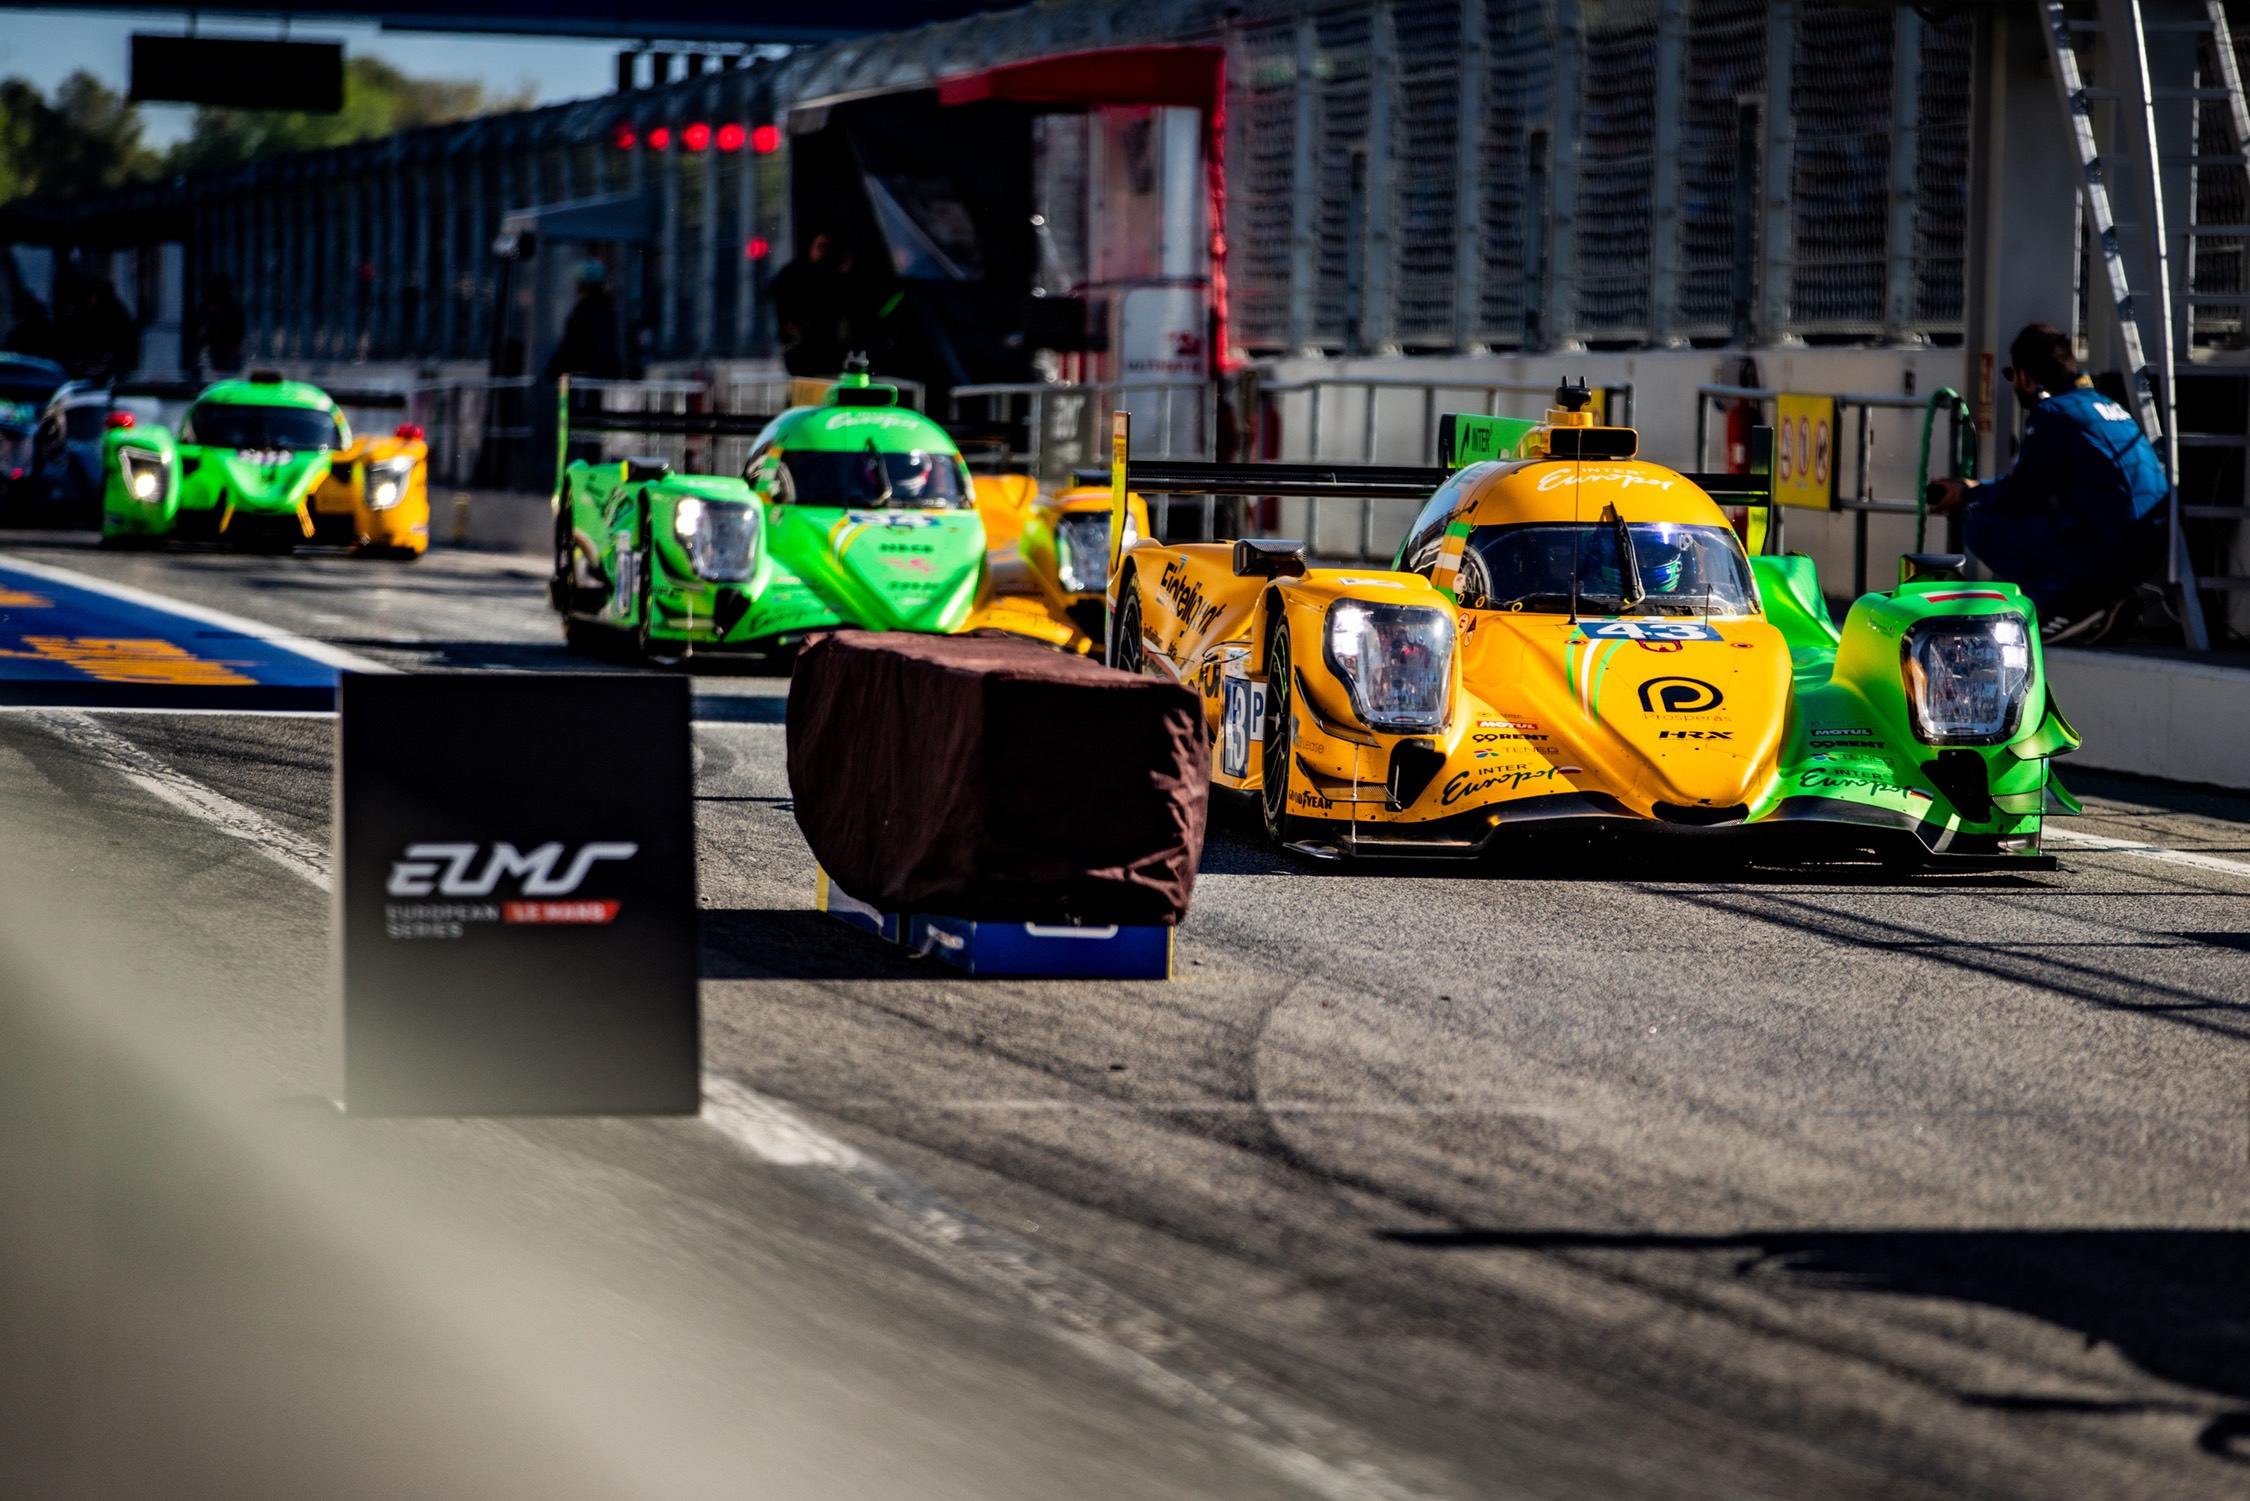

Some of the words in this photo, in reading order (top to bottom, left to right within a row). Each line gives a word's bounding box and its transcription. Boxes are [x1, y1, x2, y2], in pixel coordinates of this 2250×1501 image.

[1597, 624, 1708, 640] 43
[1643, 712, 1732, 722] Prosperas
[1479, 721, 1536, 729] MOTUL
[1478, 763, 1527, 775] INTER
[1834, 768, 1883, 780] INTER
[1441, 766, 1559, 806] Europol
[1799, 767, 1912, 799] Europol
